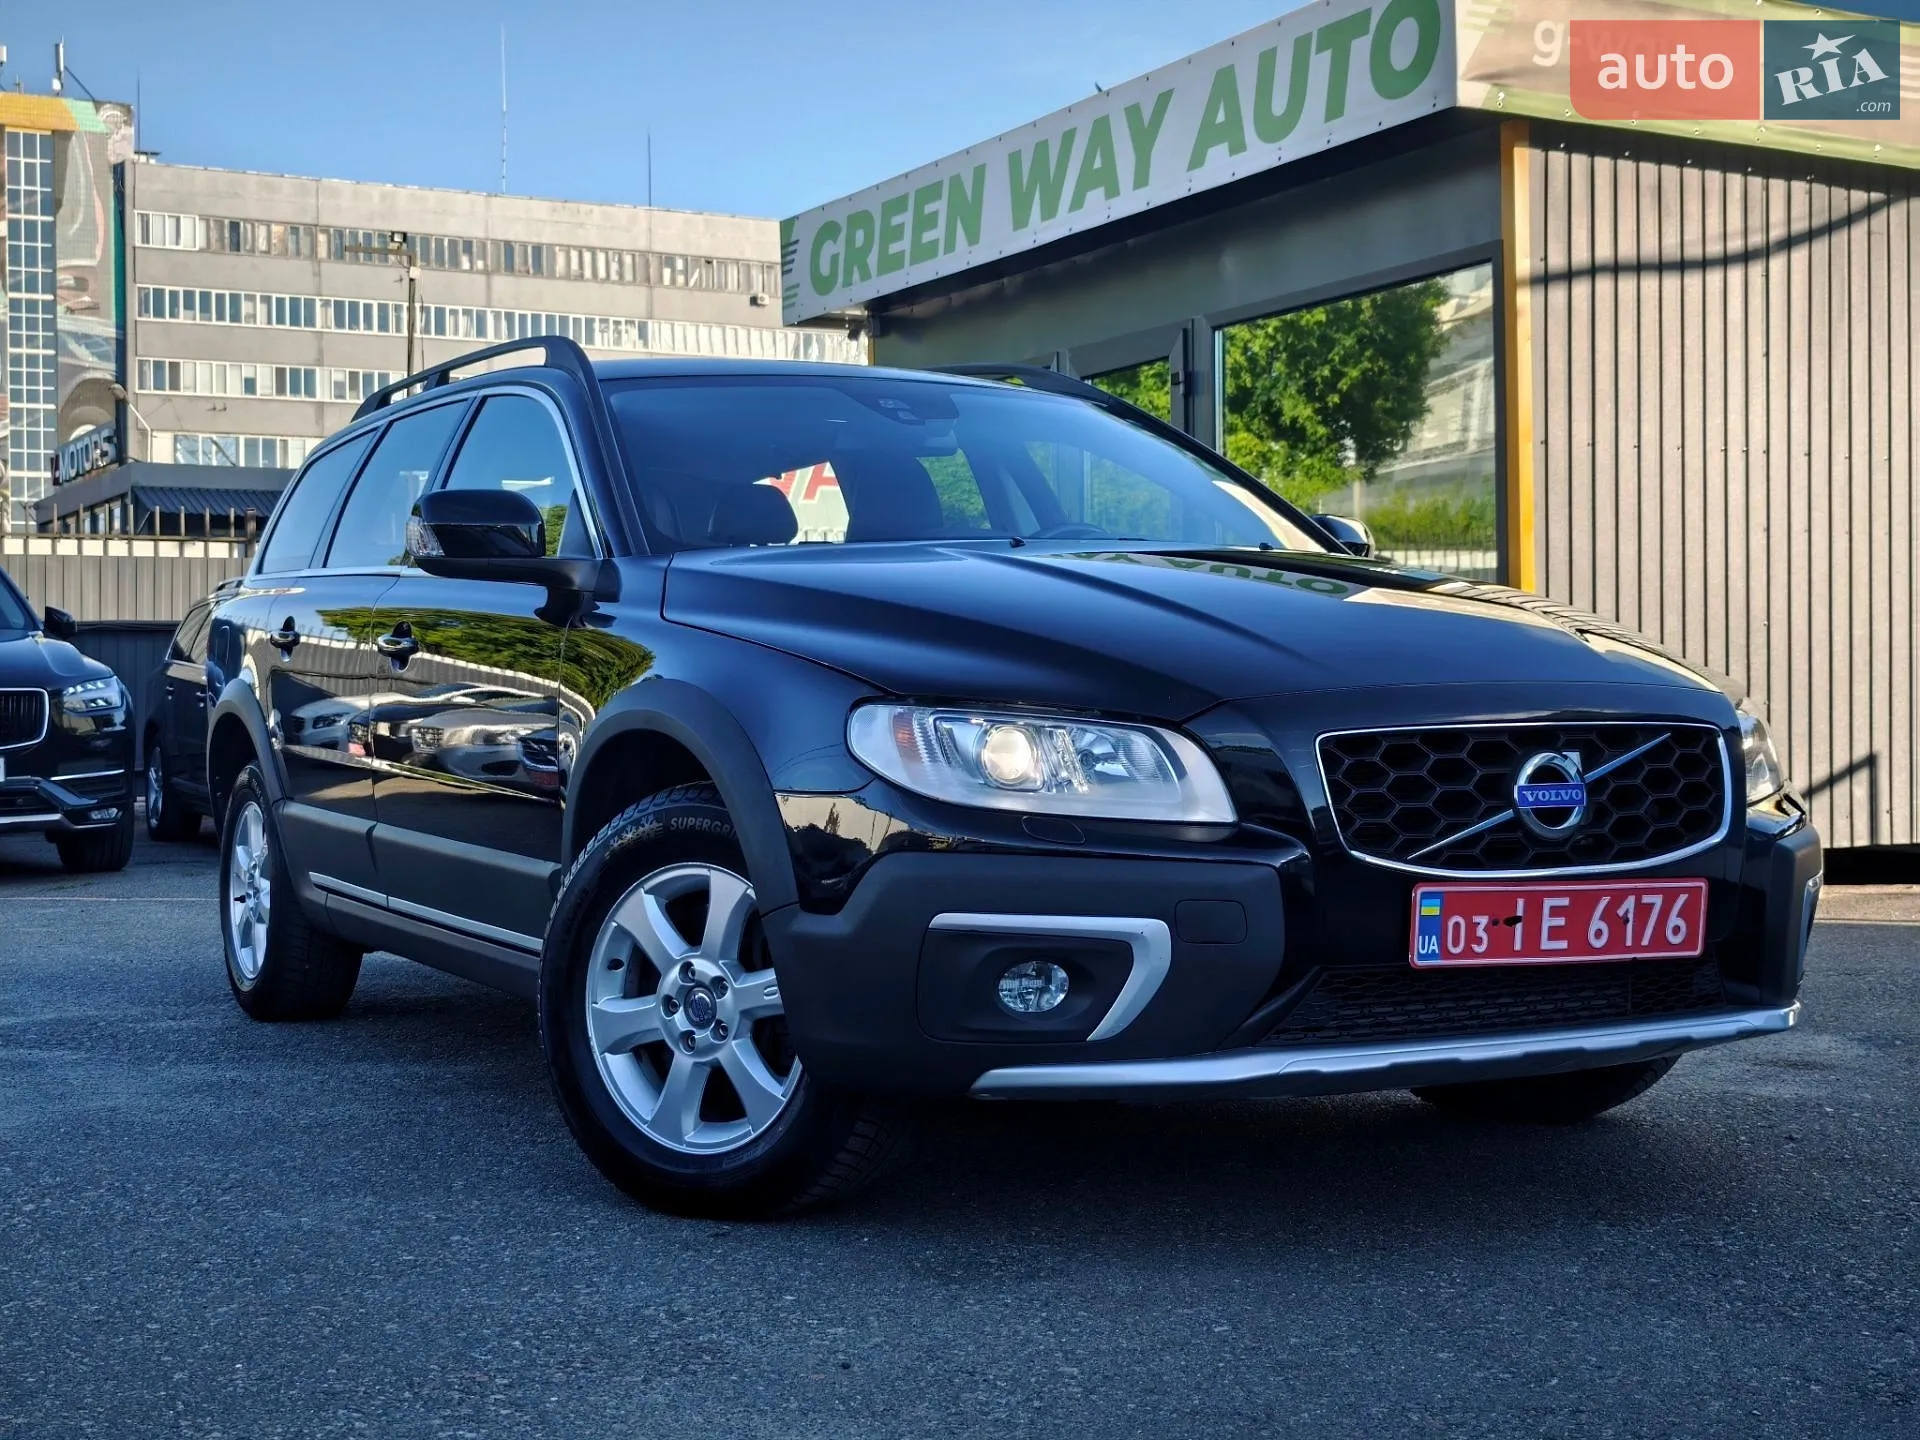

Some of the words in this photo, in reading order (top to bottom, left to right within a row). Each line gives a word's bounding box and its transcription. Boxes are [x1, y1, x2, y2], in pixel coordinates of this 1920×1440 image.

[810, 164, 986, 297] GREEN
[1008, 89, 1175, 232] WAY
[1187, 0, 1441, 172] AUTO
[1522, 789, 1582, 802] VOLVO
[1447, 914, 1489, 954] 03
[1588, 893, 1689, 949] 6176
[1418, 935, 1439, 954] UA
